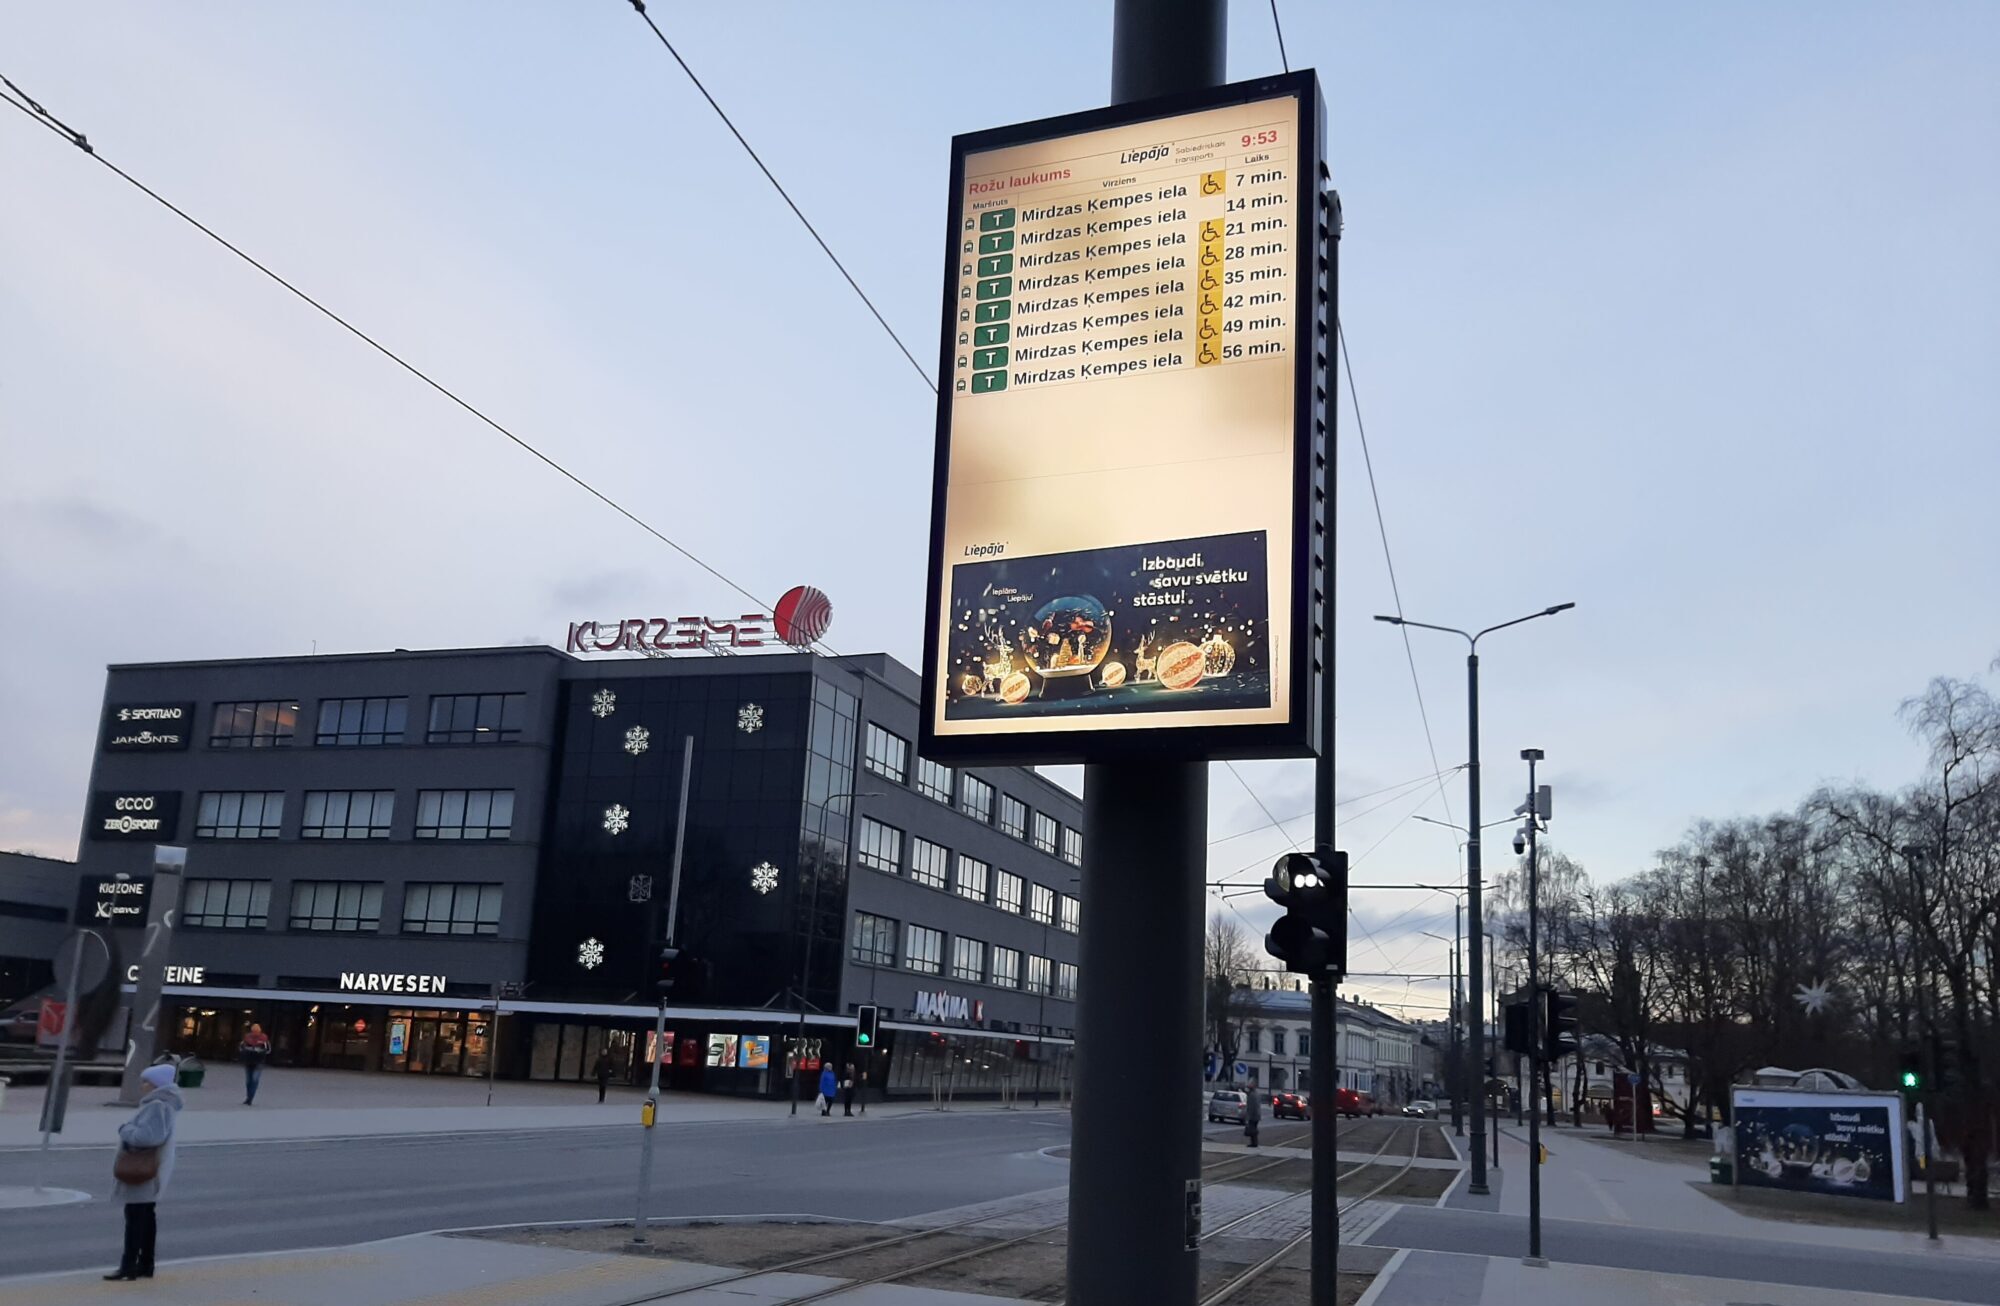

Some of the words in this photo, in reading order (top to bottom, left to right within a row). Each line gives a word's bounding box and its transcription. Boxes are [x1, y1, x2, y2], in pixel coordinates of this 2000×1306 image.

[1241, 130, 1278, 147] 9:53
[1120, 144, 1170, 164] Liepāja
[1244, 154, 1270, 164] Laiks
[969, 179, 1005, 195] Rožu
[1010, 168, 1071, 188] laukums
[1102, 176, 1137, 188] Virziens
[993, 214, 1003, 226] T
[1021, 204, 1083, 223] Mirdzas
[1087, 192, 1153, 214] Ķempes
[1158, 184, 1187, 200] iela
[1235, 174, 1245, 187] 7
[1250, 169, 1287, 185] min.
[992, 237, 1002, 249] T
[1020, 227, 1082, 246] Mirdzas
[1086, 215, 1152, 238] Ķempes
[1158, 208, 1187, 224] iela
[1226, 197, 1246, 213] 14
[1251, 192, 1288, 209] min.
[991, 261, 1001, 273] T
[1019, 250, 1081, 269] Mirdzas
[1085, 239, 1152, 261] Ķempes
[1157, 232, 1186, 247] iela
[1225, 221, 1246, 237] 21
[1251, 216, 1288, 233] min.
[990, 284, 1000, 296] T
[1018, 273, 1080, 292] Mirdzas
[1084, 262, 1151, 285] Ķempes
[1156, 255, 1186, 271] iela
[1224, 245, 1245, 261] 28
[1250, 241, 1287, 257] min.
[989, 307, 999, 319] T
[1017, 297, 1079, 315] Mirdzas
[1084, 286, 1150, 308] Ķempes
[1155, 279, 1185, 295] iela
[1224, 269, 1245, 285] 35
[1250, 265, 1287, 281] min.
[988, 330, 998, 342] T
[1016, 321, 1078, 339] Mirdzas
[1082, 310, 1149, 332] Ķempes
[1154, 303, 1184, 319] iela
[1223, 294, 1244, 309] 42
[1249, 290, 1287, 306] min.
[987, 353, 997, 365] T
[1015, 344, 1077, 362] Mirdzas
[1081, 335, 1149, 356] Ķempes
[1154, 328, 1183, 344] iela
[1222, 319, 1243, 334] 49
[1249, 314, 1286, 331] min.
[985, 376, 996, 388] T
[1014, 368, 1076, 386] Mirdzas
[1081, 359, 1148, 380] Ķempes
[1153, 352, 1183, 368] iela
[1222, 343, 1243, 359] 56
[1248, 339, 1286, 356] min.
[964, 541, 1004, 558] Liepāja
[1142, 553, 1202, 571] Izbaudi
[1154, 575, 1191, 588] savu
[1195, 568, 1248, 585] svētku
[1133, 589, 1186, 607] stāstu!
[567, 614, 766, 653] KURZEME
[131, 708, 182, 720] SPORTLAND
[112, 733, 179, 744] JAHONTS
[127, 964, 204, 984] CEINE
[340, 972, 446, 994] NARVESEN
[916, 989, 969, 1022] MAXIMA
